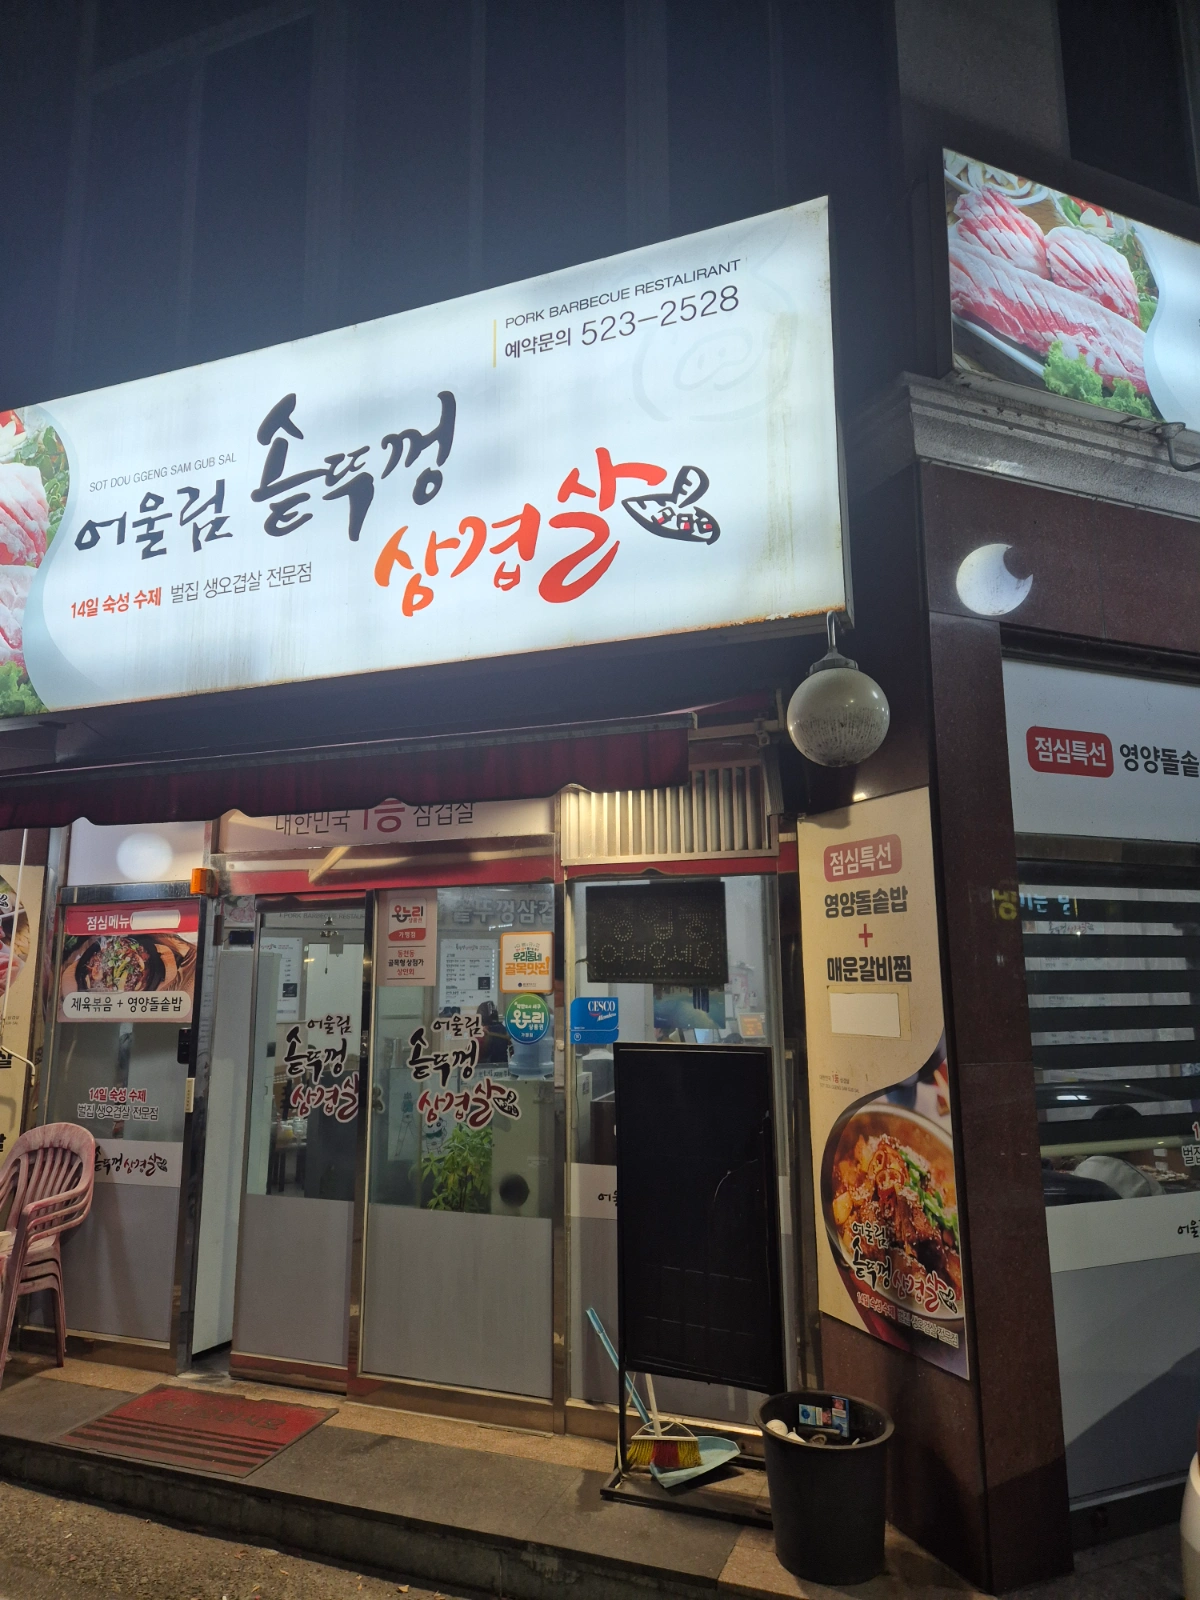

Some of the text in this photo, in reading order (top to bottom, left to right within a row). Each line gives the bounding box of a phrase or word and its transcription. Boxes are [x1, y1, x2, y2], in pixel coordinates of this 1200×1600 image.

[504, 284, 740, 359] 예약문의 523-2528
[505, 309, 545, 329] PORK
[548, 287, 631, 318] BARBECUE
[89, 452, 237, 493] SOT DOU GGENG SAM GUB SAL
[73, 478, 234, 560] 어울림
[374, 446, 668, 617] 삼겹살
[70, 561, 313, 620] 14일 숙성 수제 벌집 생오겹살 전문점
[1034, 736, 1200, 778] 점심특선 영양돌솥
[828, 842, 892, 877] 점심특선
[392, 904, 424, 923] 온누리
[824, 885, 908, 919] 영양돌솥밥
[86, 913, 130, 931] 점심메뉴
[388, 959, 405, 967] 골목형
[513, 951, 543, 962] 우리동네
[600, 940, 714, 969] 어서오세요
[827, 954, 912, 983] 매운갈비찜
[70, 996, 113, 1012] 제육볶음
[127, 995, 183, 1013] 영양돌솥밥
[588, 1000, 616, 1012] CESCO
[307, 1014, 352, 1036] 어울림
[431, 1014, 484, 1037] 어울림
[510, 1009, 545, 1029] 온누리
[88, 1087, 147, 1103] 14일 숙성 수제
[290, 1073, 359, 1122] 삼겹살
[417, 1078, 506, 1128] 삼겹살
[77, 1103, 159, 1121] 벌집 생오겹살 전문점
[124, 1153, 162, 1177] 삼겹살
[852, 1221, 888, 1248] 어울림
[893, 1270, 947, 1313] 삼겹살
